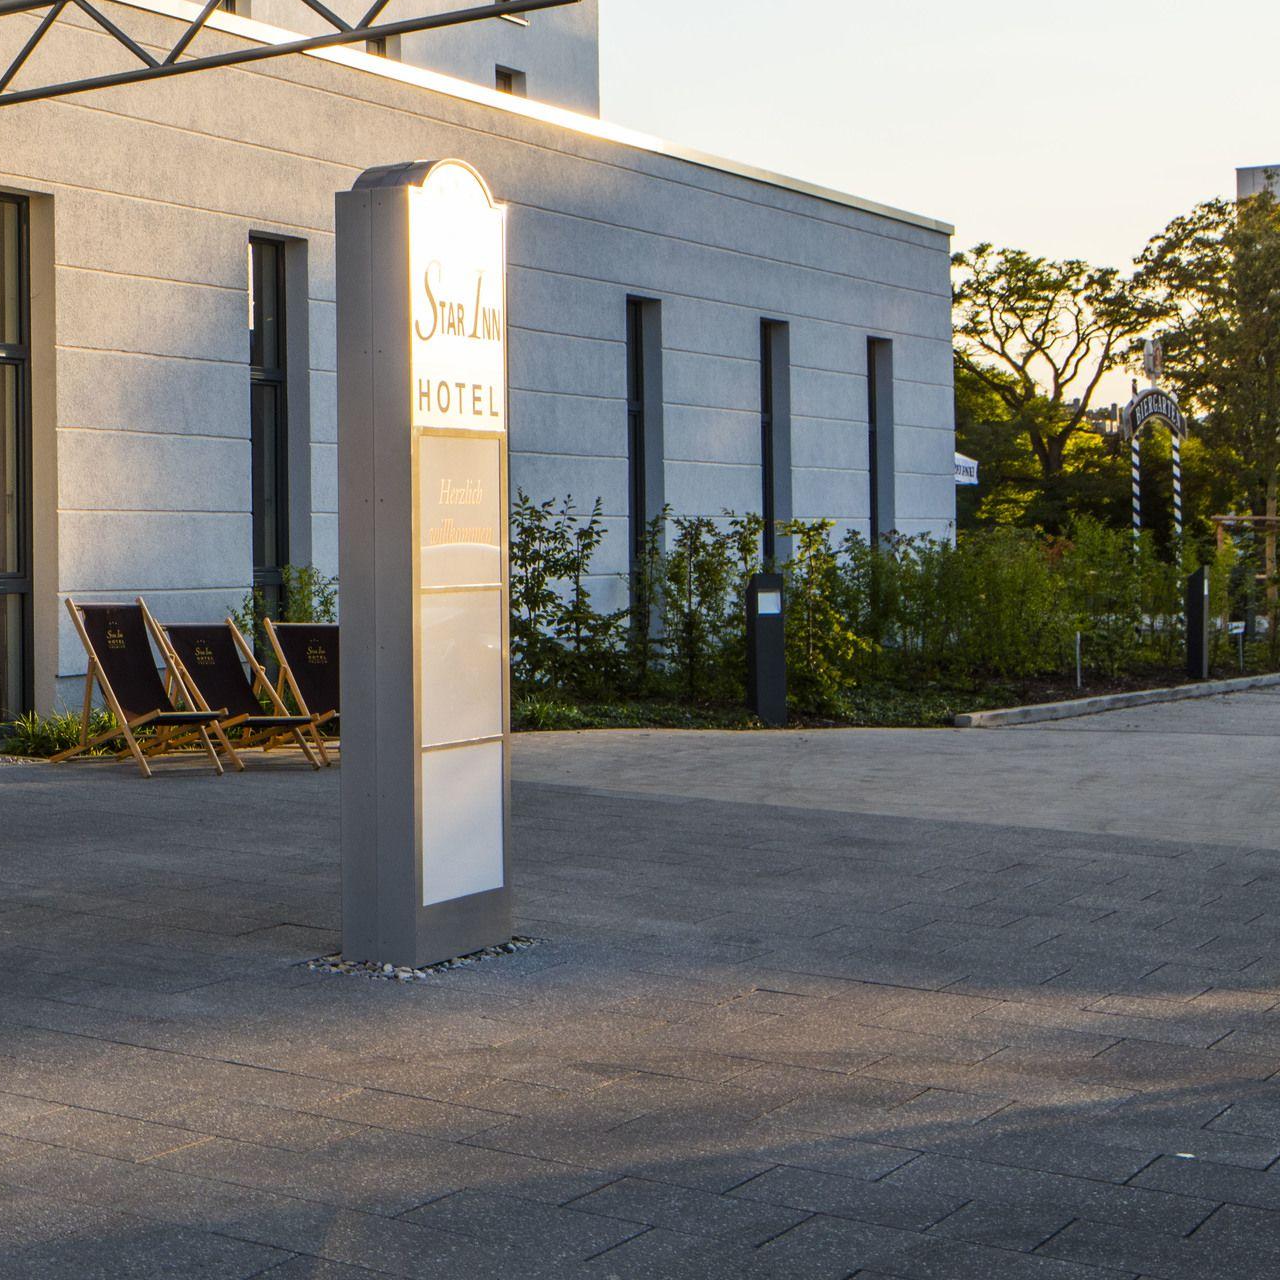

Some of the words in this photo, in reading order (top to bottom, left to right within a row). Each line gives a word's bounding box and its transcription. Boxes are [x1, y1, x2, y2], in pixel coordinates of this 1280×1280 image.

[418, 378, 500, 418] HOTEL
[1135, 394, 1181, 429] BIERGARTEN
[438, 478, 483, 505] Herzlich
[429, 518, 493, 545] willkommen
